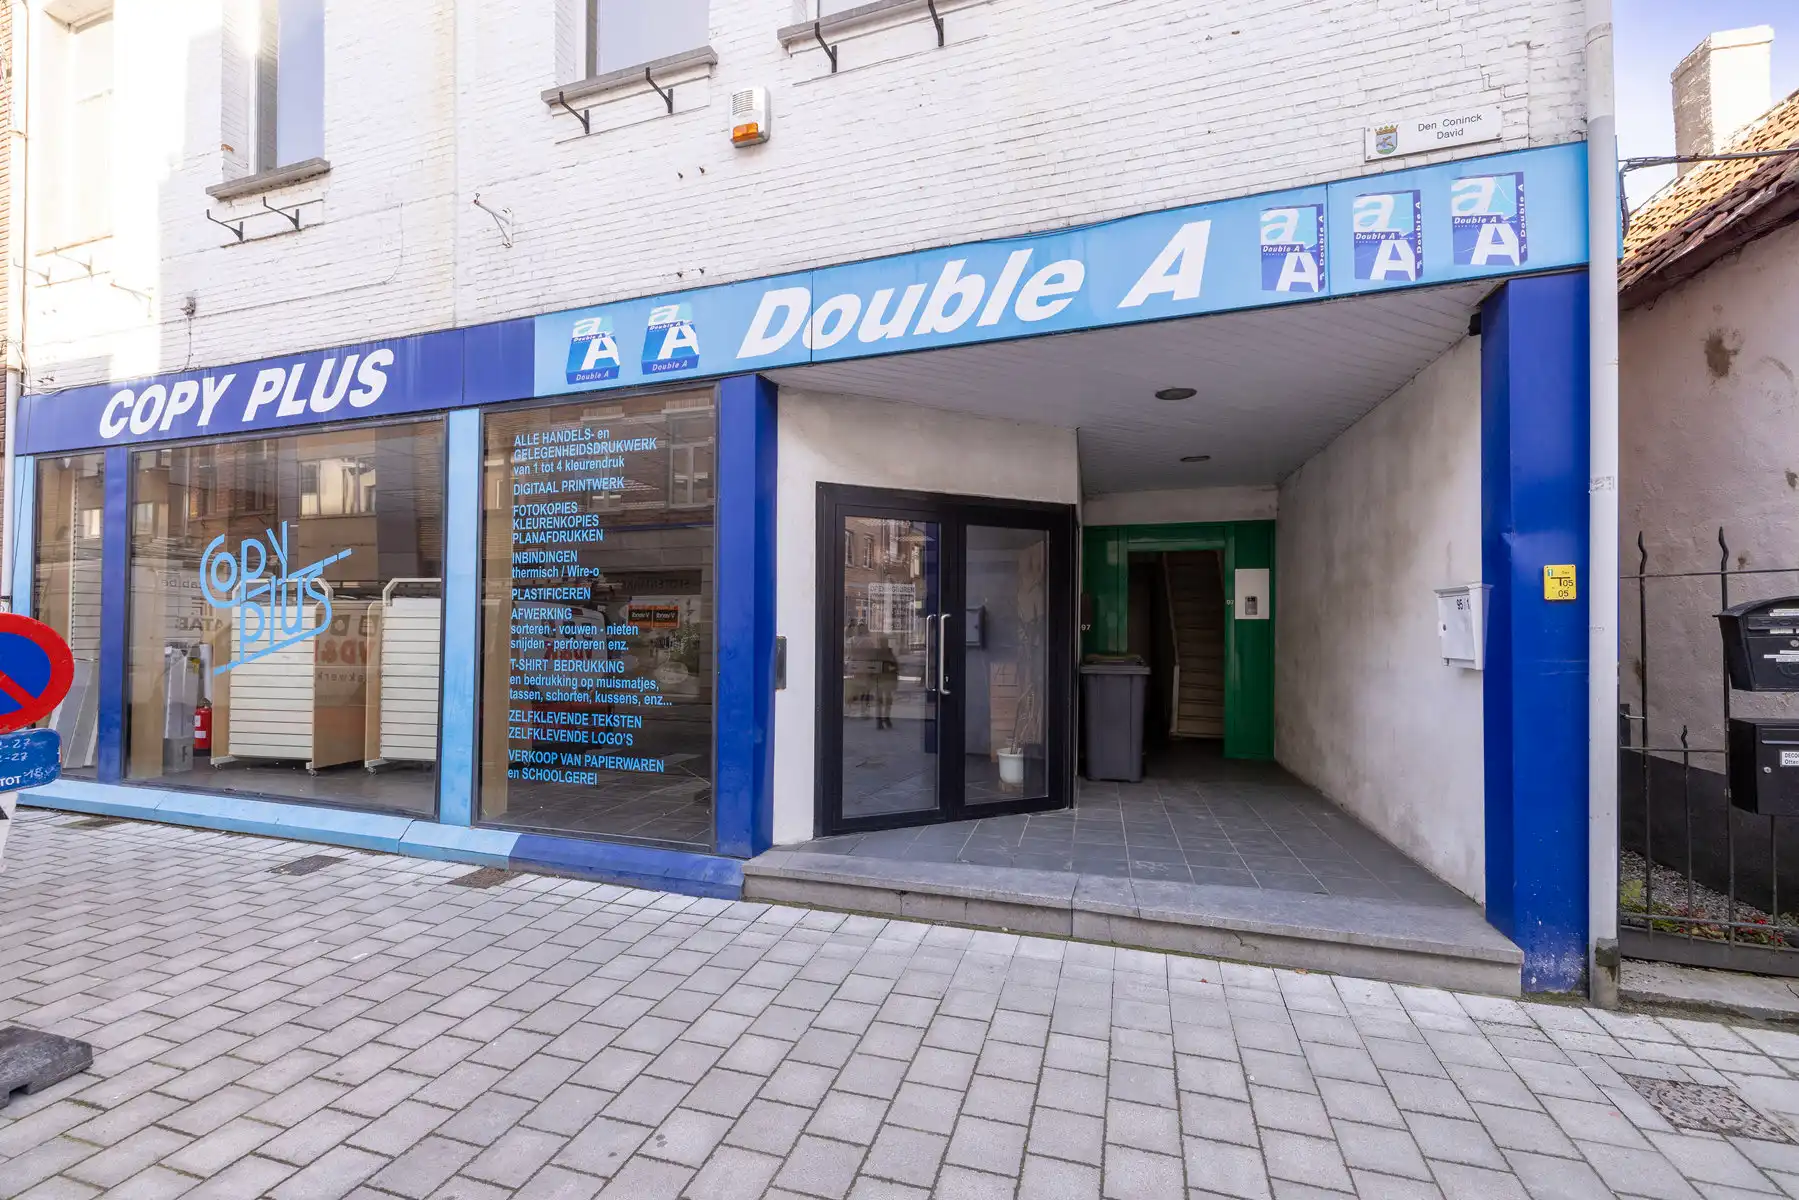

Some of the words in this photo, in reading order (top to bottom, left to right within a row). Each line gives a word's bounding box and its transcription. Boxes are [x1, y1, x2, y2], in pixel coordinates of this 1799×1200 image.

[1418, 122, 1437, 132] Den
[1442, 113, 1482, 127] Coninck
[1436, 128, 1464, 140] David
[1454, 216, 1487, 224] Double
[1355, 232, 1386, 240] Double
[1470, 223, 1520, 265] A
[1369, 240, 1416, 282] A
[1276, 252, 1319, 292] A
[736, 248, 1085, 359] Double
[1117, 219, 1212, 308] A
[657, 324, 700, 360] A
[581, 336, 620, 370] A
[652, 362, 680, 371] Double
[576, 371, 602, 381] Double
[99, 373, 236, 439] COPY
[242, 349, 394, 422] PLUS
[514, 433, 539, 447] ALLE
[542, 429, 594, 444] HANDELS-
[598, 429, 609, 439] en
[514, 437, 657, 461] GELEGENHEIDSDRUKWERK
[514, 466, 530, 475] van
[533, 464, 538, 473] 1
[541, 463, 554, 472] tot
[556, 462, 562, 472] 4
[566, 456, 625, 472] kleurendruk
[514, 481, 559, 495] DIGITAAL
[562, 477, 625, 492] PRINTWERK
[513, 502, 578, 516] FOTOKOPIES
[513, 515, 599, 530] KLEURENKOPIES
[512, 529, 604, 544] PLANAFDRUKKEN
[512, 551, 577, 564] INBINDINGEN
[512, 566, 558, 578] thermisch
[567, 565, 599, 577] Wire-o
[512, 587, 590, 600] PLASTIFICEREN
[511, 608, 572, 619] AFWERKING
[511, 624, 550, 635] sorteren
[559, 625, 597, 635] vouwen
[607, 624, 639, 635] nieten
[511, 638, 545, 651] snijden
[554, 639, 604, 652] perforeren
[608, 640, 629, 650] enz.
[510, 659, 549, 671] T-SHIRT
[554, 660, 624, 672] BEDRUKKING
[510, 675, 521, 685] en
[524, 674, 578, 689] bedrukking
[581, 678, 593, 688] op
[596, 676, 659, 691] muismatjes,
[510, 688, 543, 702] tassen,
[546, 689, 591, 703] schorten,
[595, 691, 641, 706] kussens,
[644, 694, 672, 706] enz...
[509, 710, 589, 725] ZELFKLEVENDE
[592, 713, 642, 728] TEKSTEN
[508, 727, 589, 743] ZELFKLEVENDE
[592, 732, 633, 746] LOGO'S
[508, 749, 558, 764] VERKOOP
[560, 753, 581, 766] VAN
[584, 754, 664, 772] PAPIERWAREN
[0, 775, 21, 787] TOT
[508, 768, 519, 779] en
[522, 768, 597, 785] SCHOOLGEREI
